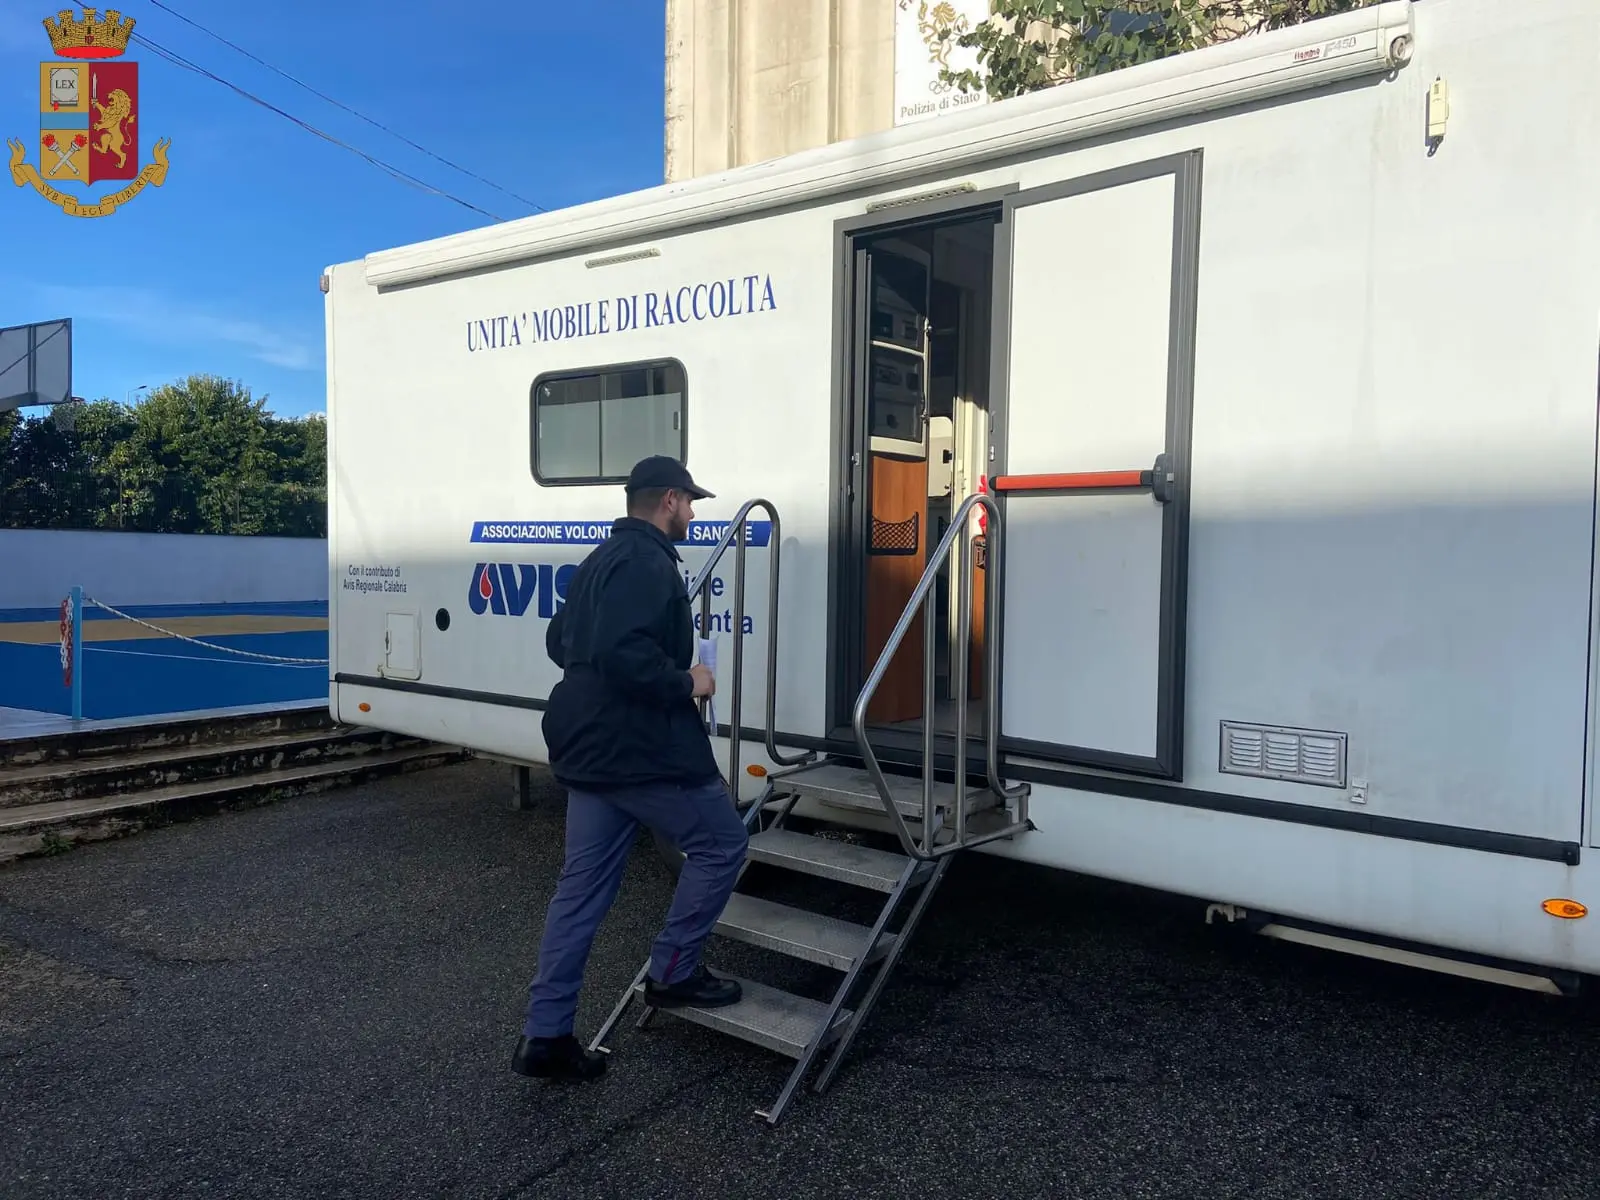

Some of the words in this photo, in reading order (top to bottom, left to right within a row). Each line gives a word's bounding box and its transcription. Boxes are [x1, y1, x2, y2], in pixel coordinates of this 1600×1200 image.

[900, 100, 936, 117] Polizia
[938, 97, 950, 110] di
[952, 93, 980, 107] Stato
[466, 313, 527, 352] UNITA'
[532, 299, 610, 344] MOBILE
[616, 295, 638, 332] DI
[644, 273, 777, 328] RACCOLTA
[481, 525, 562, 539] ASSOCIAZIONE
[565, 525, 612, 539] VOLONT
[692, 525, 753, 542] SANE
[348, 564, 360, 576] Con
[361, 564, 365, 576] il
[365, 564, 394, 577] contributo
[394, 566, 401, 577] di
[343, 578, 355, 591] Avis
[356, 578, 383, 594] Regionale
[383, 580, 407, 592] Calabria
